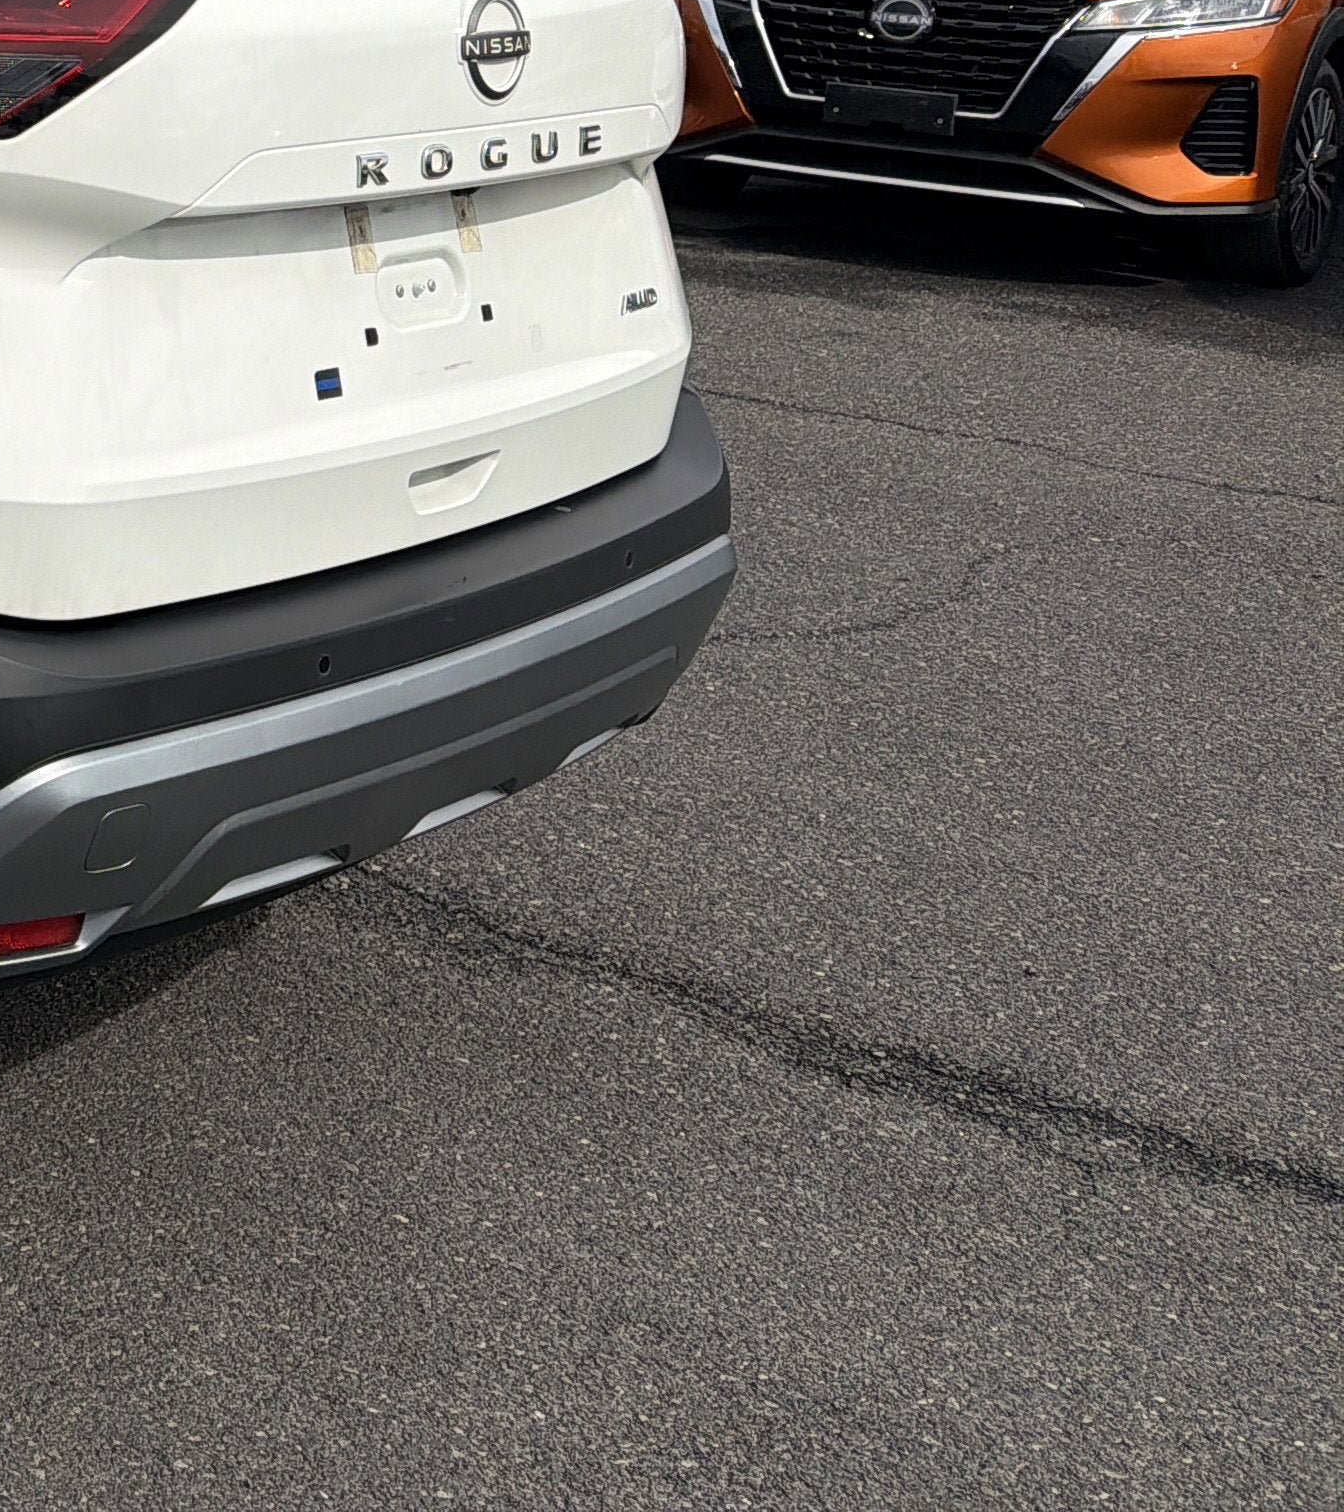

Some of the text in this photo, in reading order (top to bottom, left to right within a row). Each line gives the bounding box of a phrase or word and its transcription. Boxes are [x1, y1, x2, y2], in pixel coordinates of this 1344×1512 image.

[871, 11, 933, 26] NISSAN
[465, 35, 531, 57] NISSAN
[356, 124, 602, 189] ROGUE
